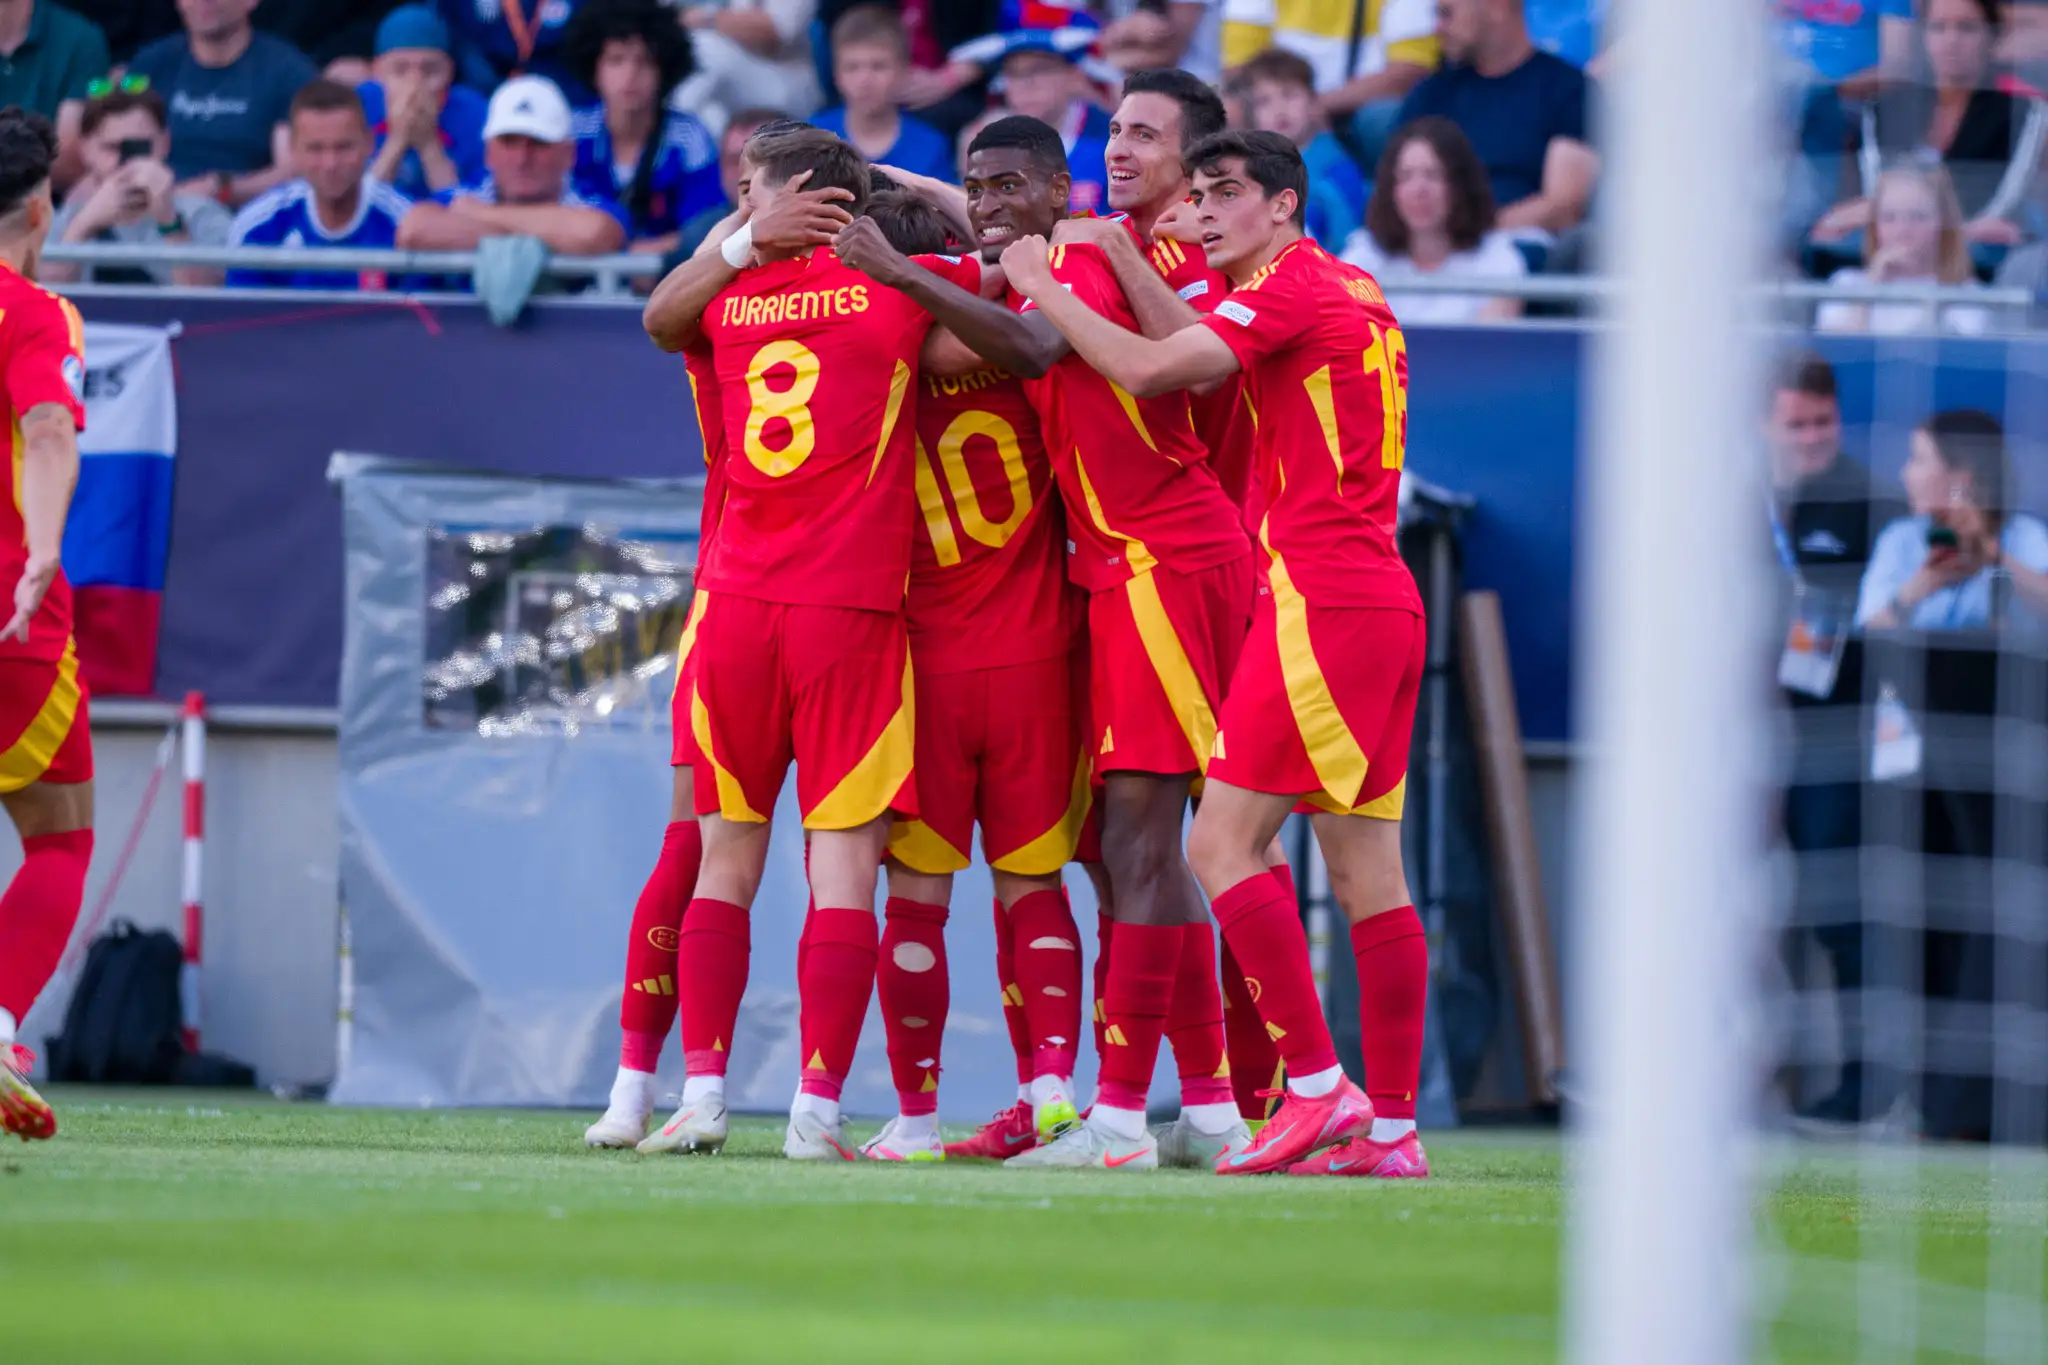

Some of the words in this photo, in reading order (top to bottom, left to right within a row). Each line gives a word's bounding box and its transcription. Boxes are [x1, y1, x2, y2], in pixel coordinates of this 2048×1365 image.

[721, 285, 869, 327] TURRIENTES
[743, 339, 820, 477] 8
[1363, 321, 1407, 472] 16
[915, 409, 1033, 567] 10
